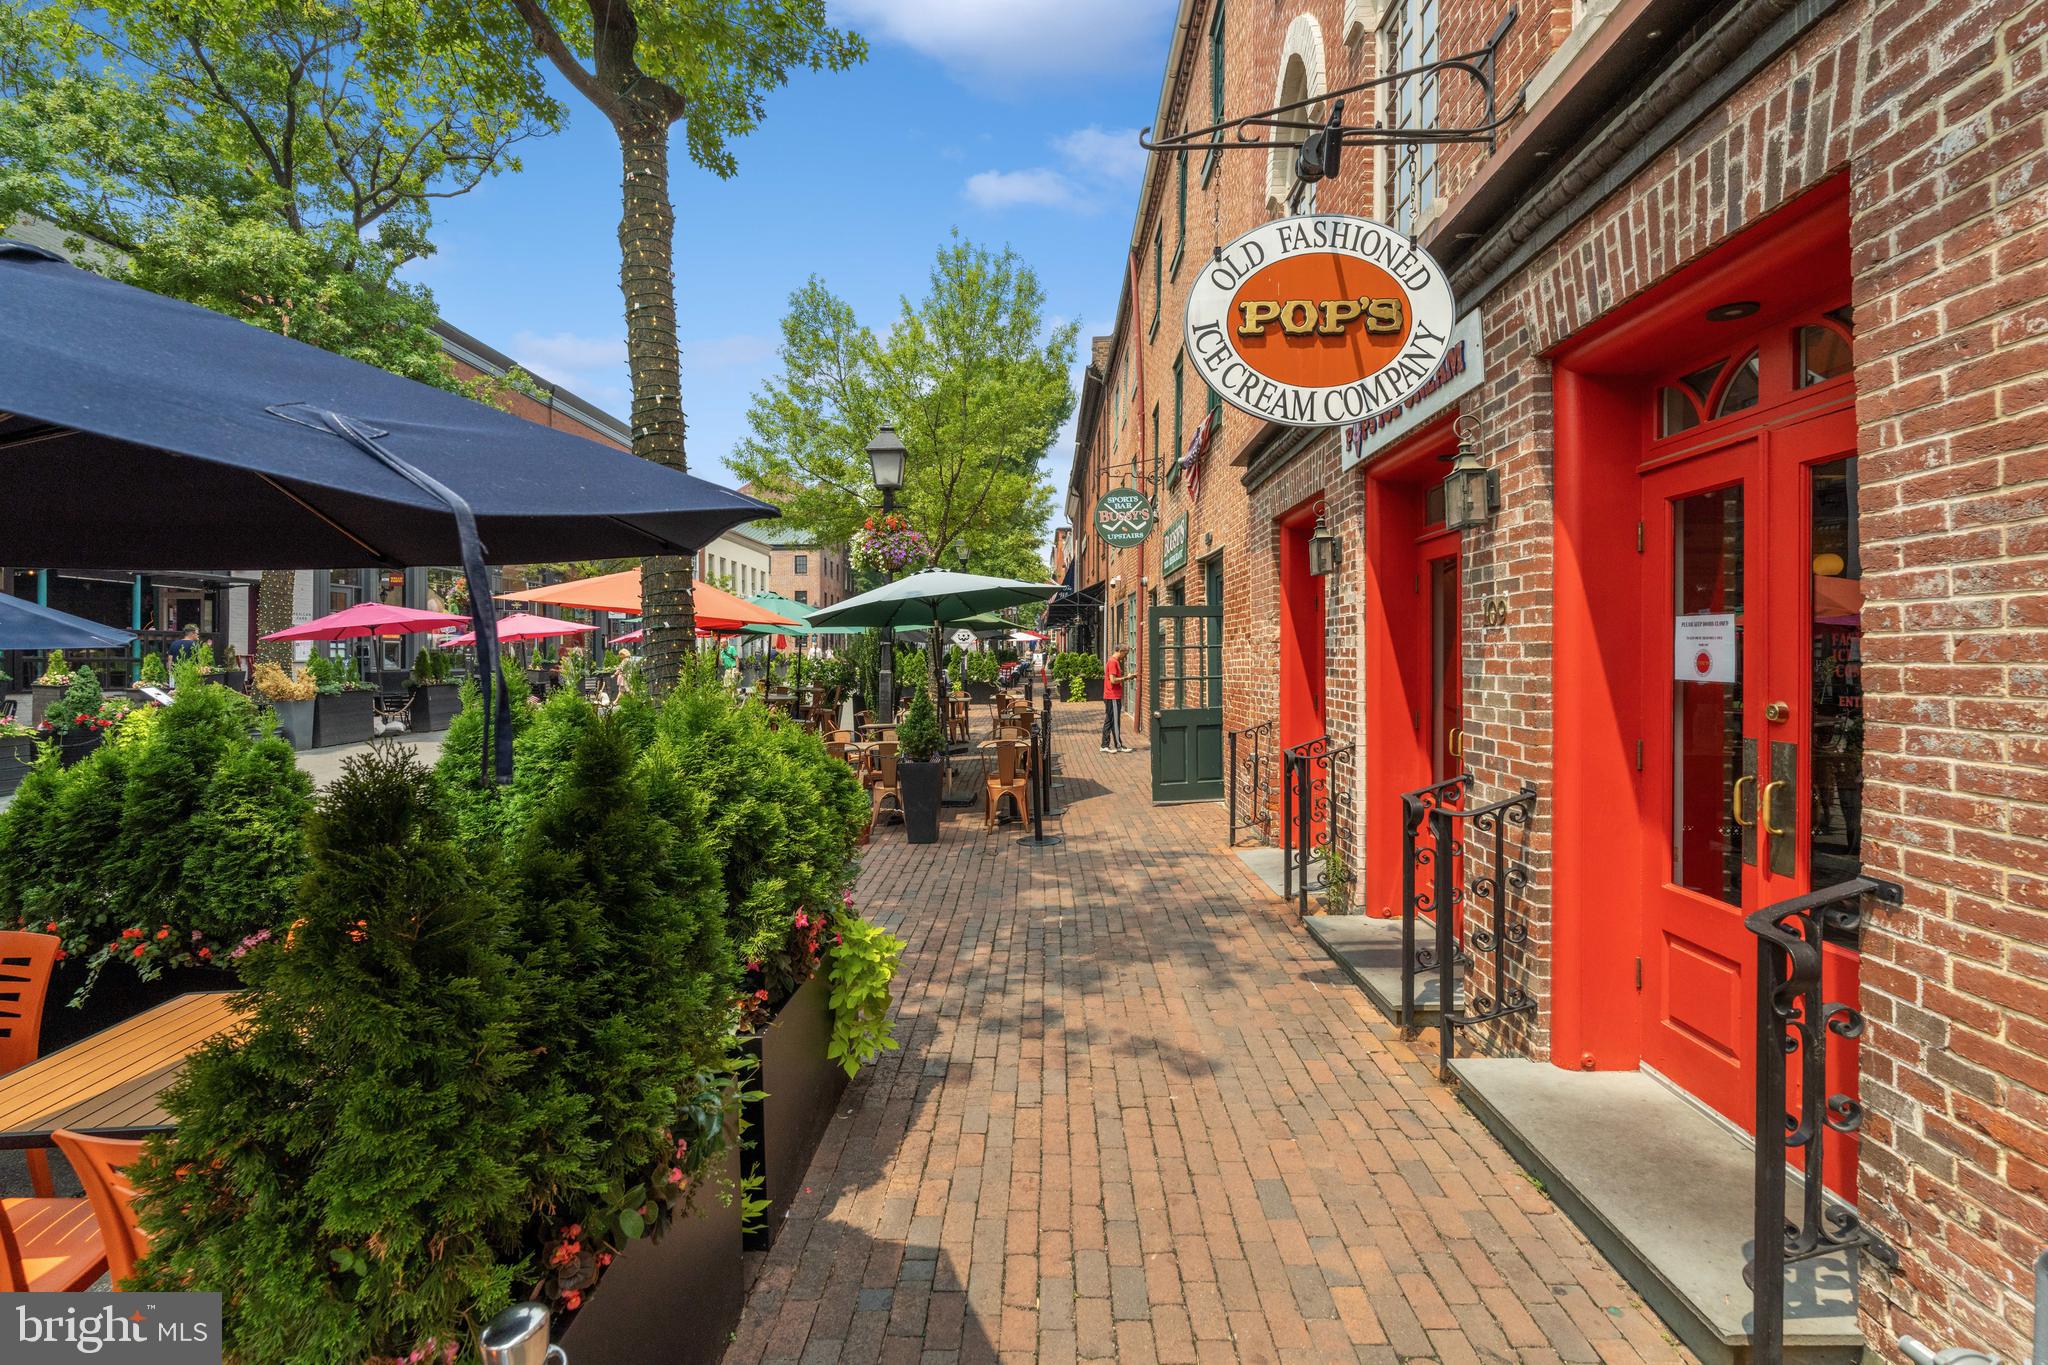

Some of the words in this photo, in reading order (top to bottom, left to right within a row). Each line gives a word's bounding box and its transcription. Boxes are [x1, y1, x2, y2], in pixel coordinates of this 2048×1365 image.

[1211, 241, 1265, 291] OLD
[1276, 221, 1431, 291] FASHIONED
[1238, 297, 1404, 337] POP'S
[1192, 320, 1233, 372] ICE
[1222, 362, 1318, 422] CREAM
[1324, 317, 1447, 422] COMPANY
[1107, 496, 1139, 504] SPORTS
[1098, 508, 1150, 523] BUGSY'S
[1107, 532, 1144, 540] UPSTAIRS
[1484, 600, 1507, 626] 109
